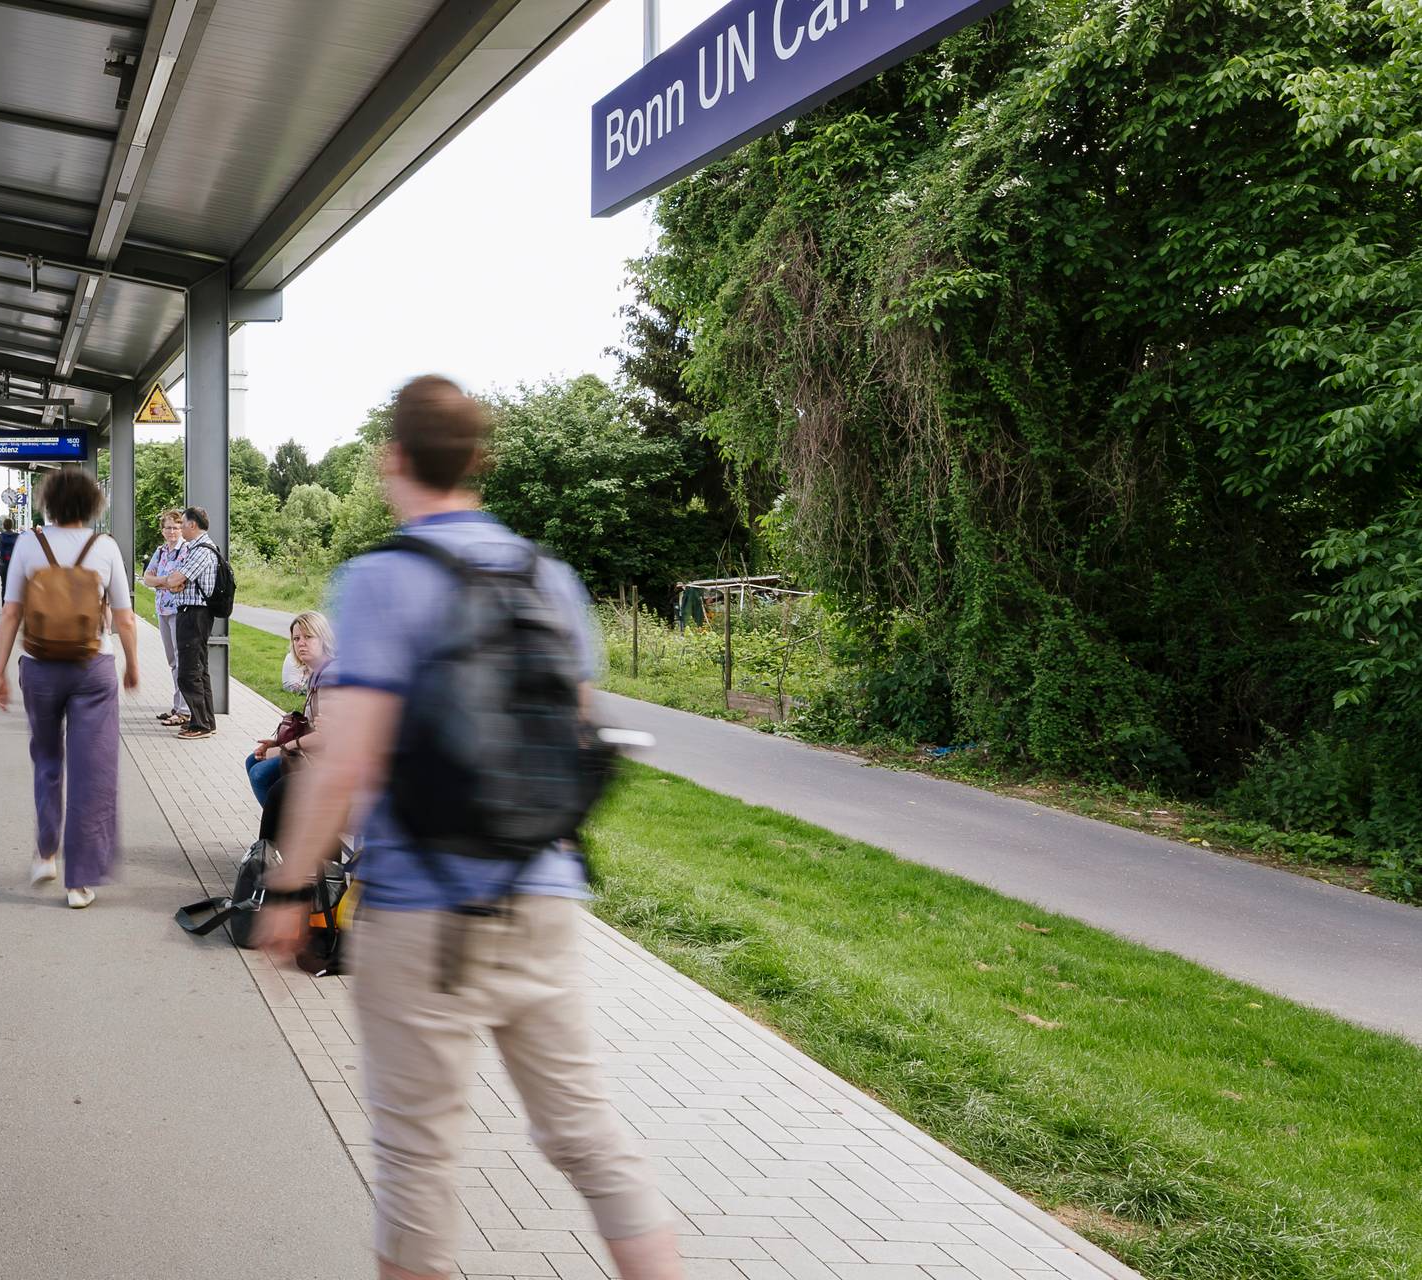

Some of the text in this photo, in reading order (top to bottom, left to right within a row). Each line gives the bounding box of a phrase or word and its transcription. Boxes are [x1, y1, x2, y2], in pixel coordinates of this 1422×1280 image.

[605, 79, 685, 171] Bonn
[698, 10, 756, 110] UN
[18, 495, 24, 503] 2
